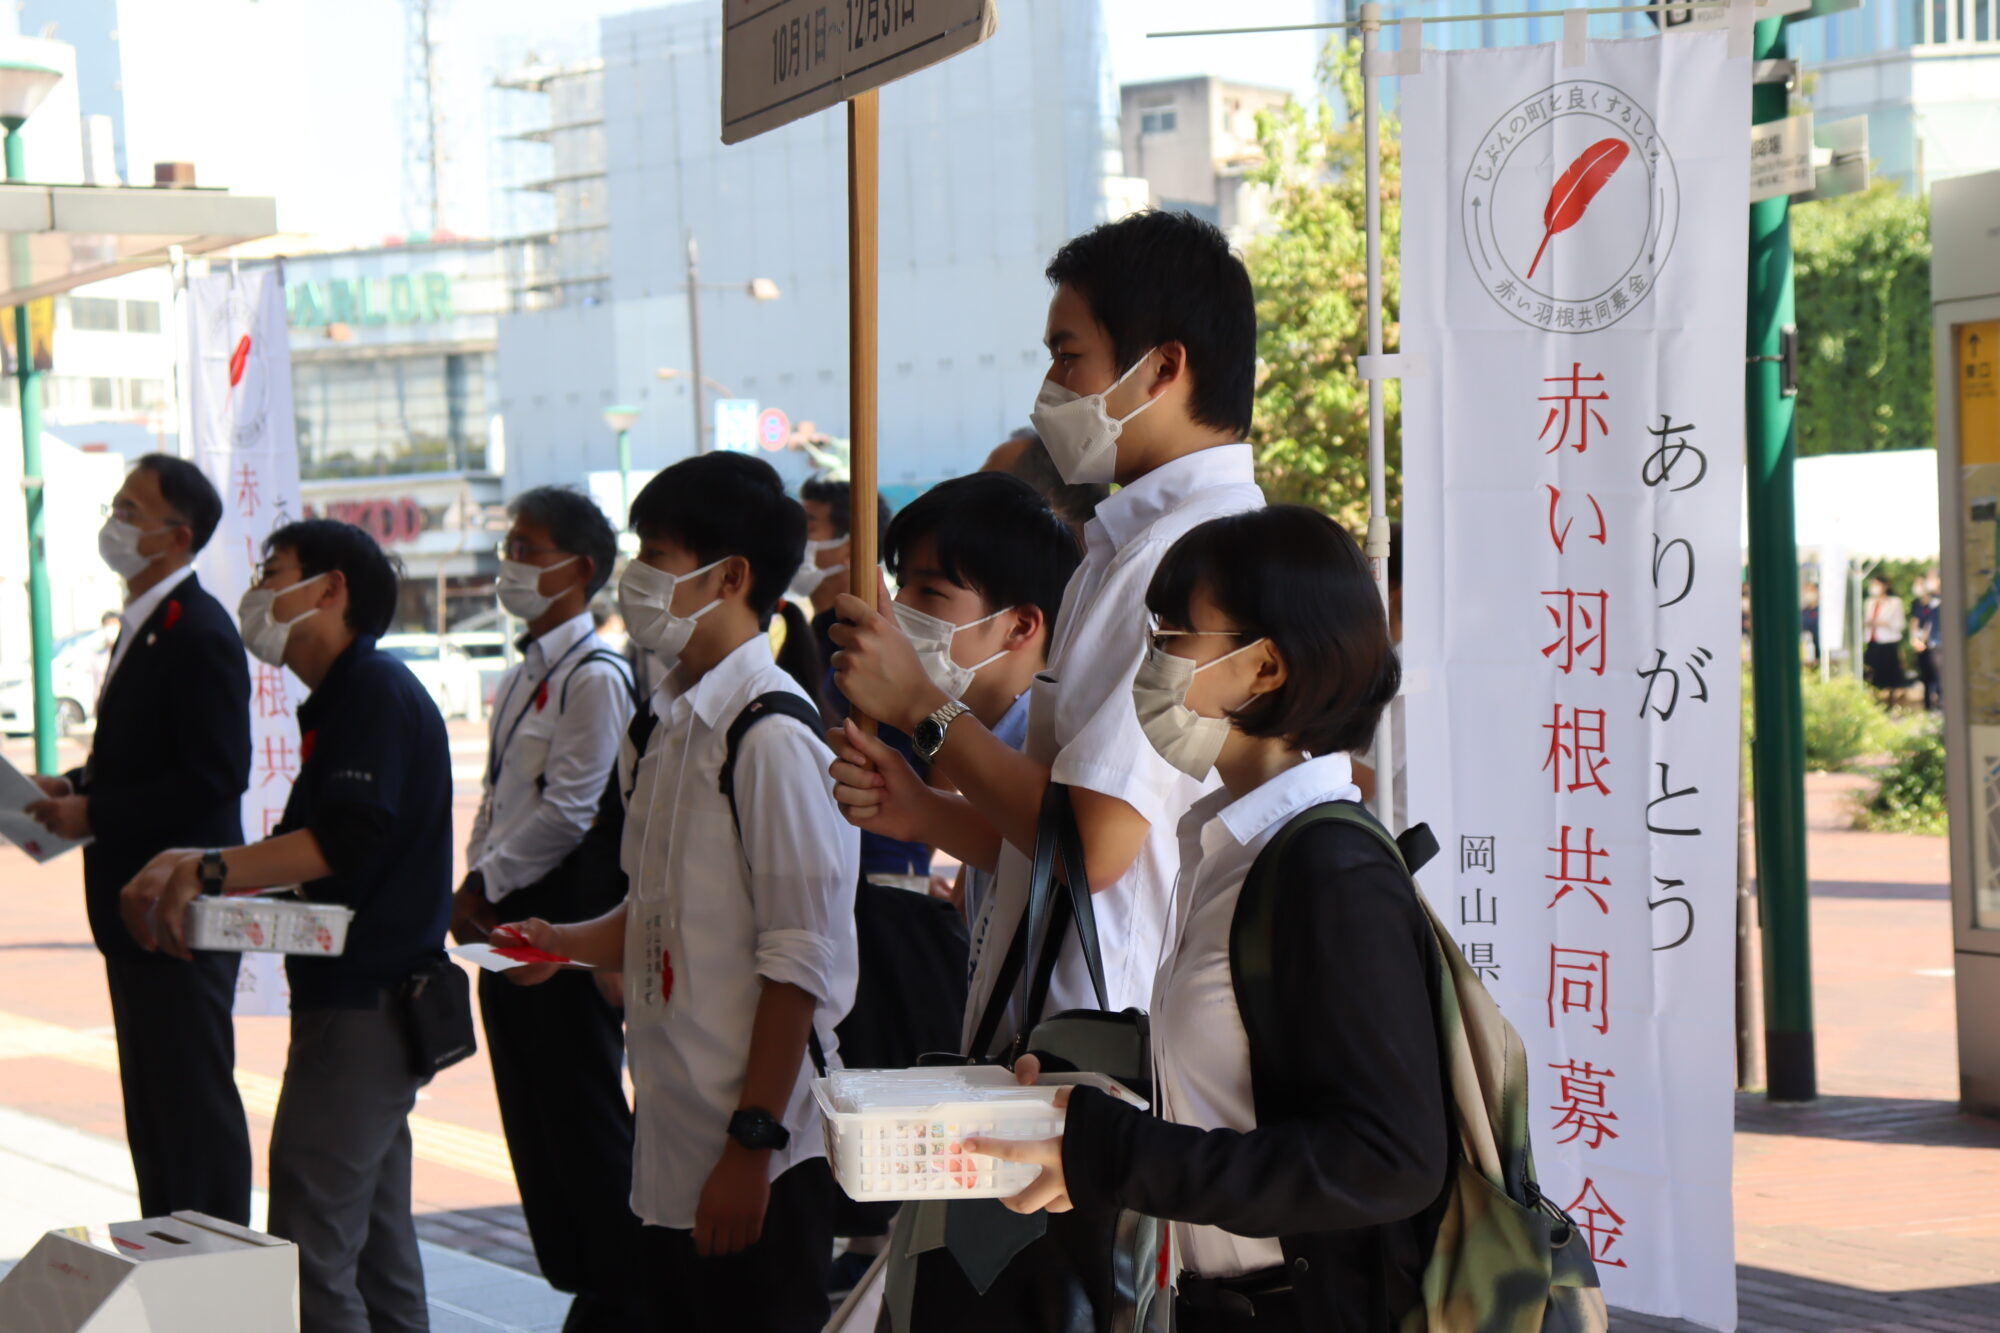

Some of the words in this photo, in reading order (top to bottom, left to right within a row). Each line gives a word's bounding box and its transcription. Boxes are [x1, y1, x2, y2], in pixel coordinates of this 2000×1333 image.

[1494, 273, 1649, 329] 赤い羽根共同募金
[1537, 362, 1628, 1269] 赤い羽根共同募金
[1637, 413, 1714, 952] ありがとう
